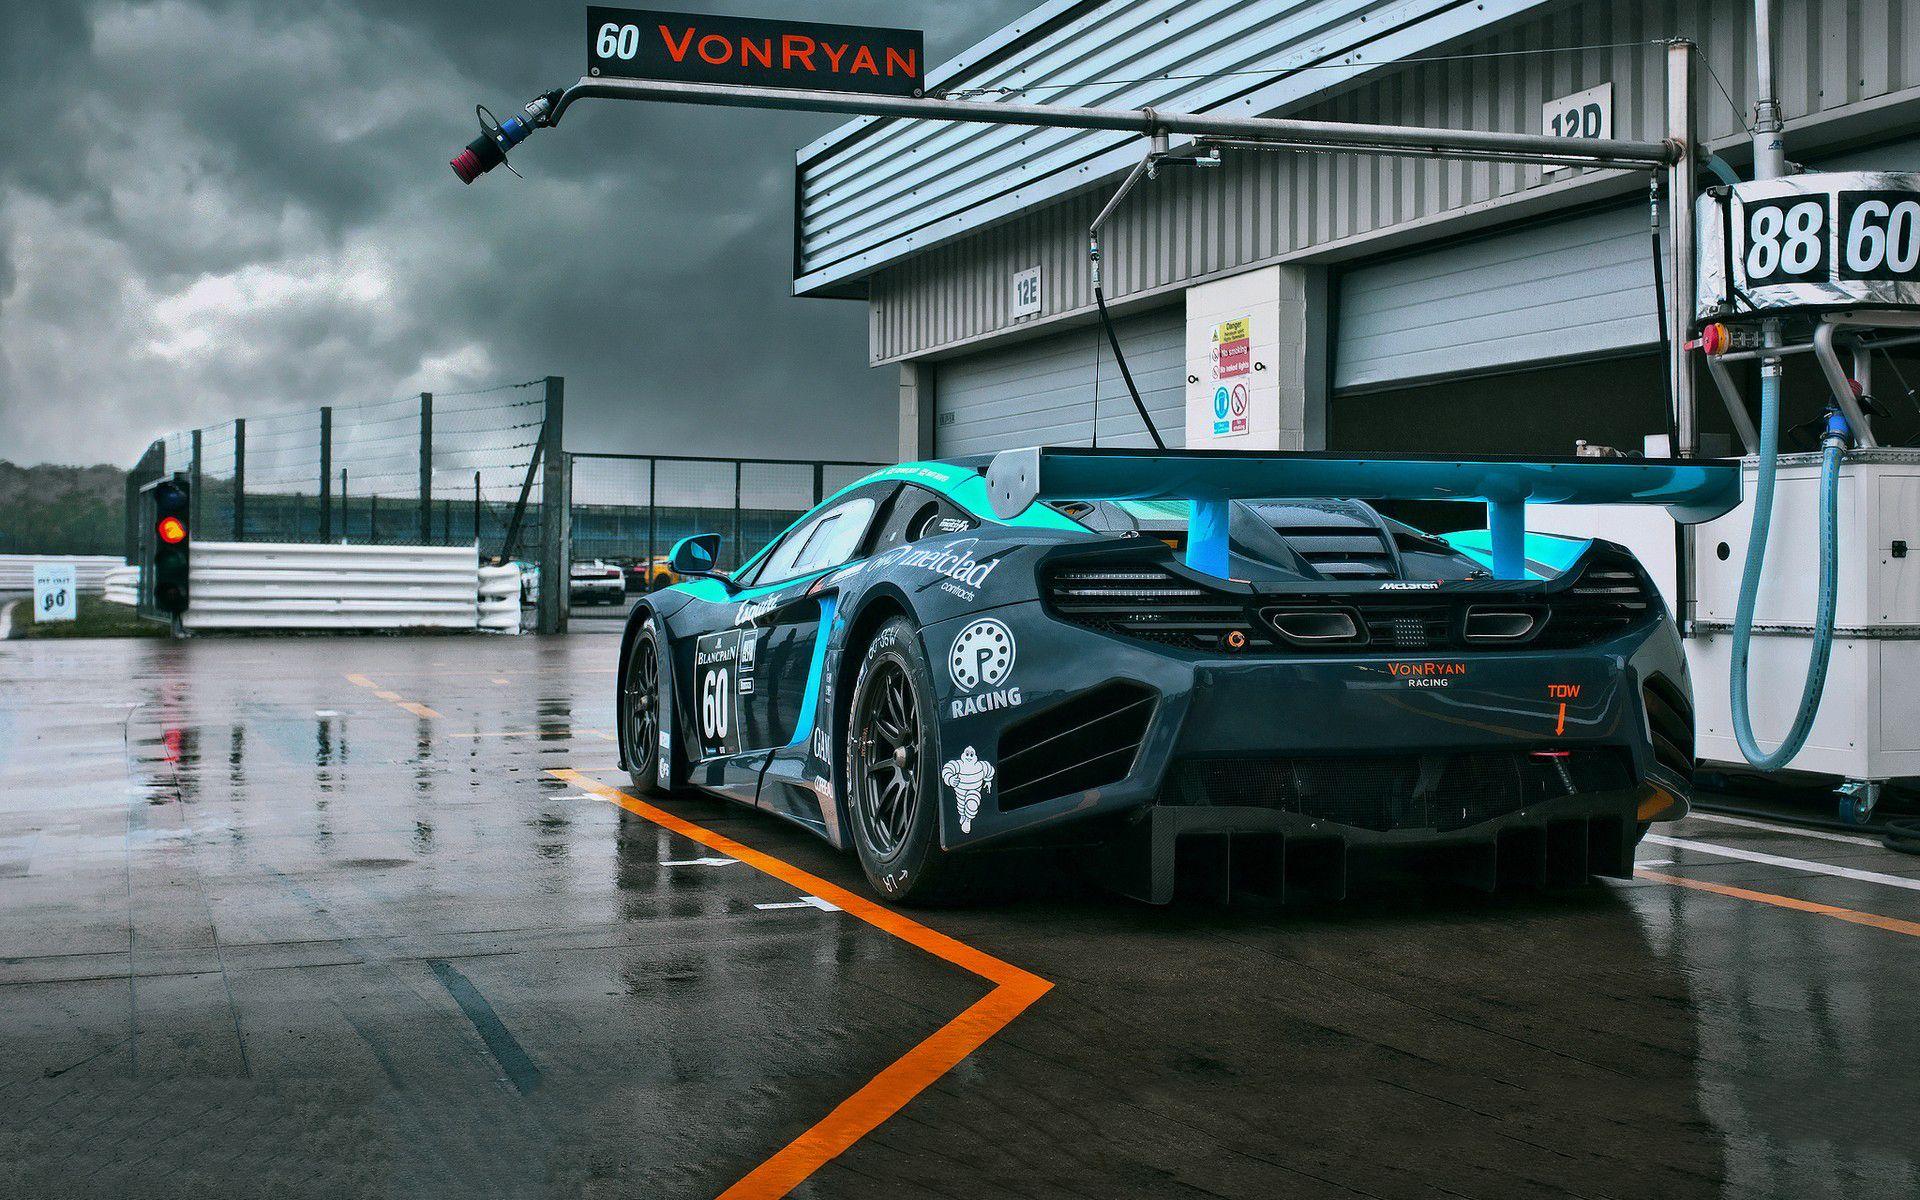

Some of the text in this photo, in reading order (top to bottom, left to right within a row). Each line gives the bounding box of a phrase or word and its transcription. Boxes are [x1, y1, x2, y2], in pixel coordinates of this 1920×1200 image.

[596, 22, 640, 60] 60
[1552, 103, 1602, 138] 12D
[1747, 201, 1825, 279] 88
[1846, 200, 1920, 273] 60
[1018, 277, 1037, 306] 12E
[900, 546, 1000, 590] metclad
[941, 582, 975, 602] contracts
[1380, 582, 1440, 590] McLaren
[698, 646, 737, 666] BLANCPAIN
[1408, 679, 1449, 688] RACING
[1548, 685, 1580, 698] TOW
[703, 668, 728, 739] 60
[951, 687, 1022, 719] RACING
